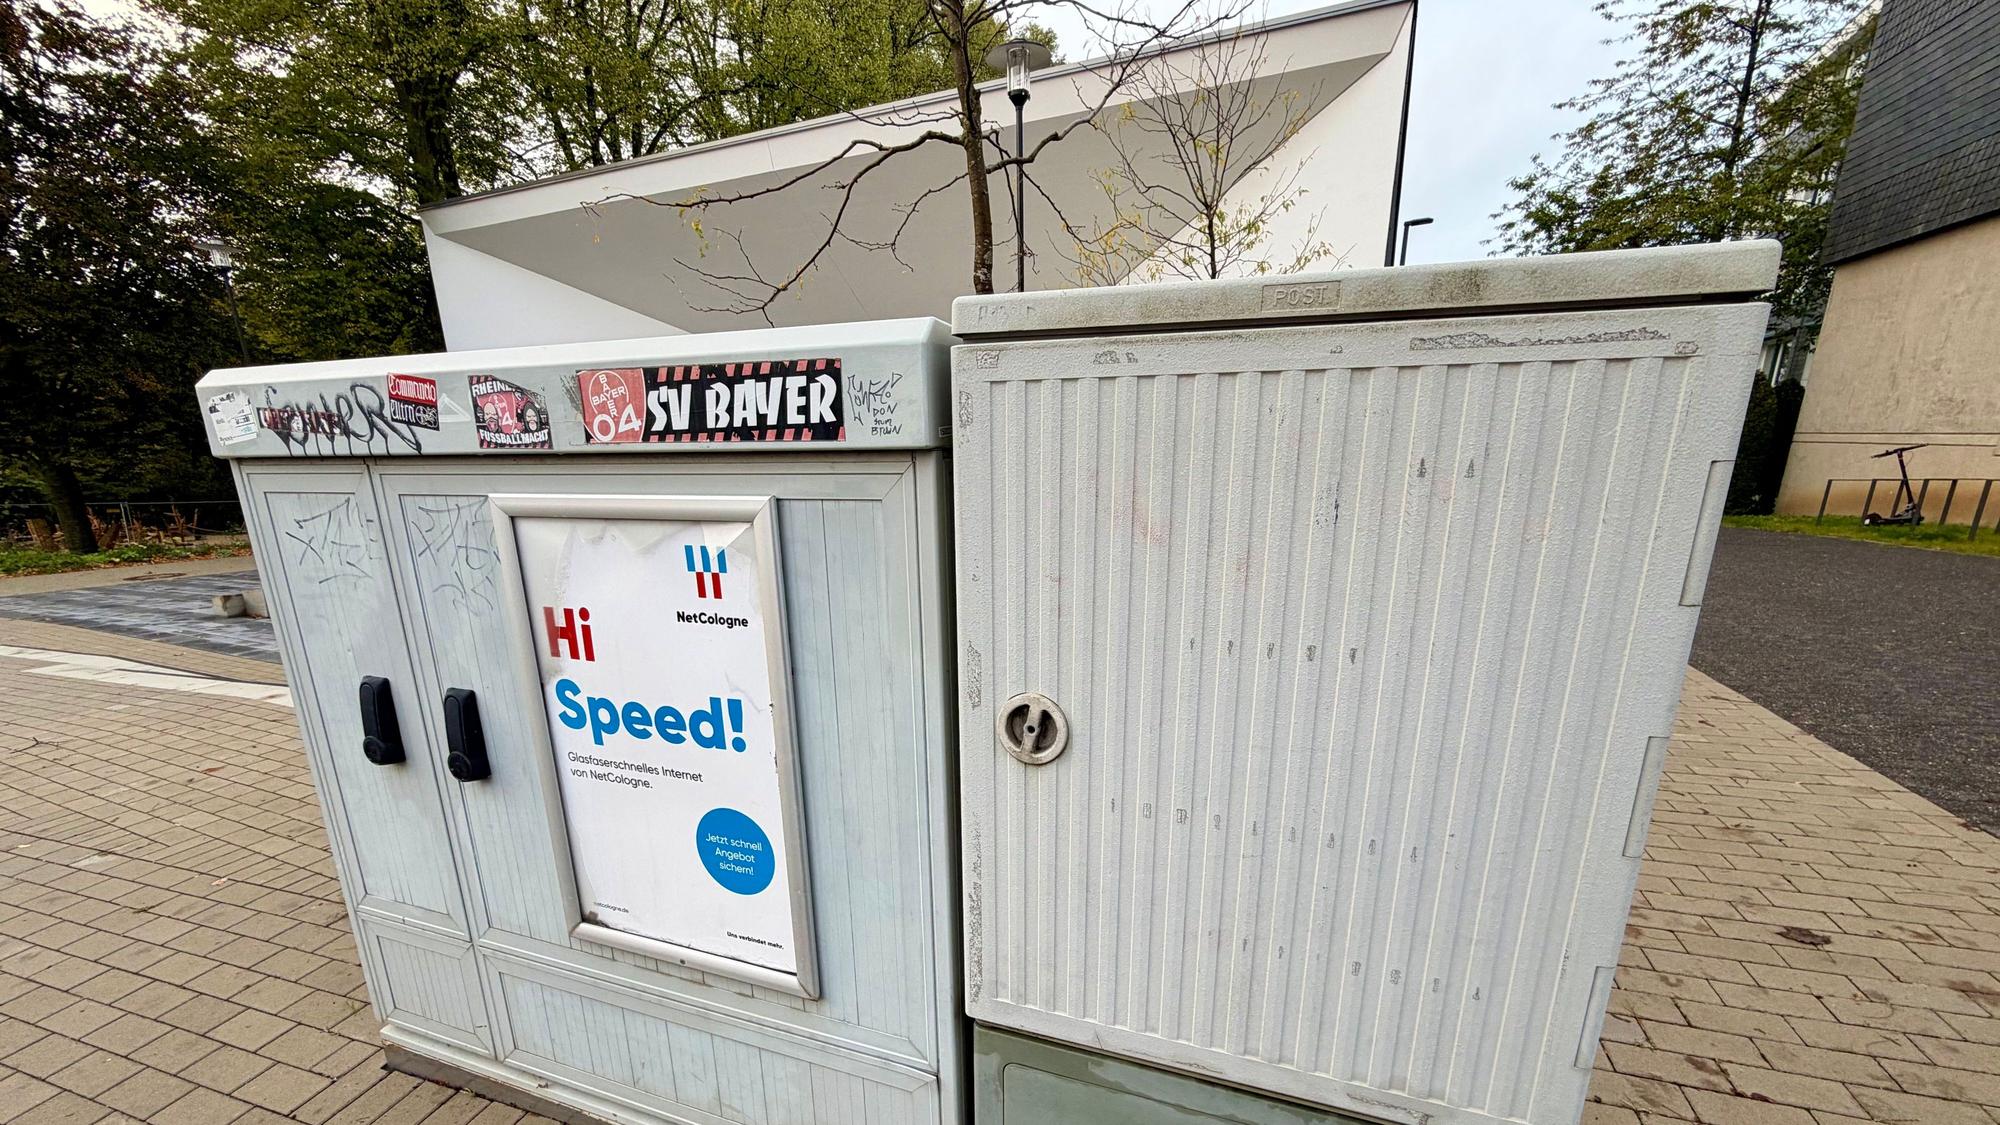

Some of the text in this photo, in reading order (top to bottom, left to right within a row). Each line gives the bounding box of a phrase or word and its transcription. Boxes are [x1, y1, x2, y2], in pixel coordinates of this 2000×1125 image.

[1273, 285, 1329, 308] POST
[592, 386, 626, 406] BAYER
[599, 374, 620, 418] BAYER
[647, 384, 692, 432] SV
[705, 373, 837, 428] BAYER
[593, 403, 642, 441] 04
[479, 428, 550, 445] FUSSBALLMACHT
[676, 611, 749, 628] NetCologne
[543, 606, 595, 662] Hi
[555, 678, 747, 753] Speed!
[567, 751, 704, 783] Glasfaserschnelles Internet
[570, 768, 653, 789] von NetCologne.
[705, 833, 762, 852] Jetzt schnell
[715, 847, 756, 863] Angebot
[719, 861, 754, 876] sichern!
[726, 930, 738, 939] Uns
[738, 934, 767, 946] verbindet
